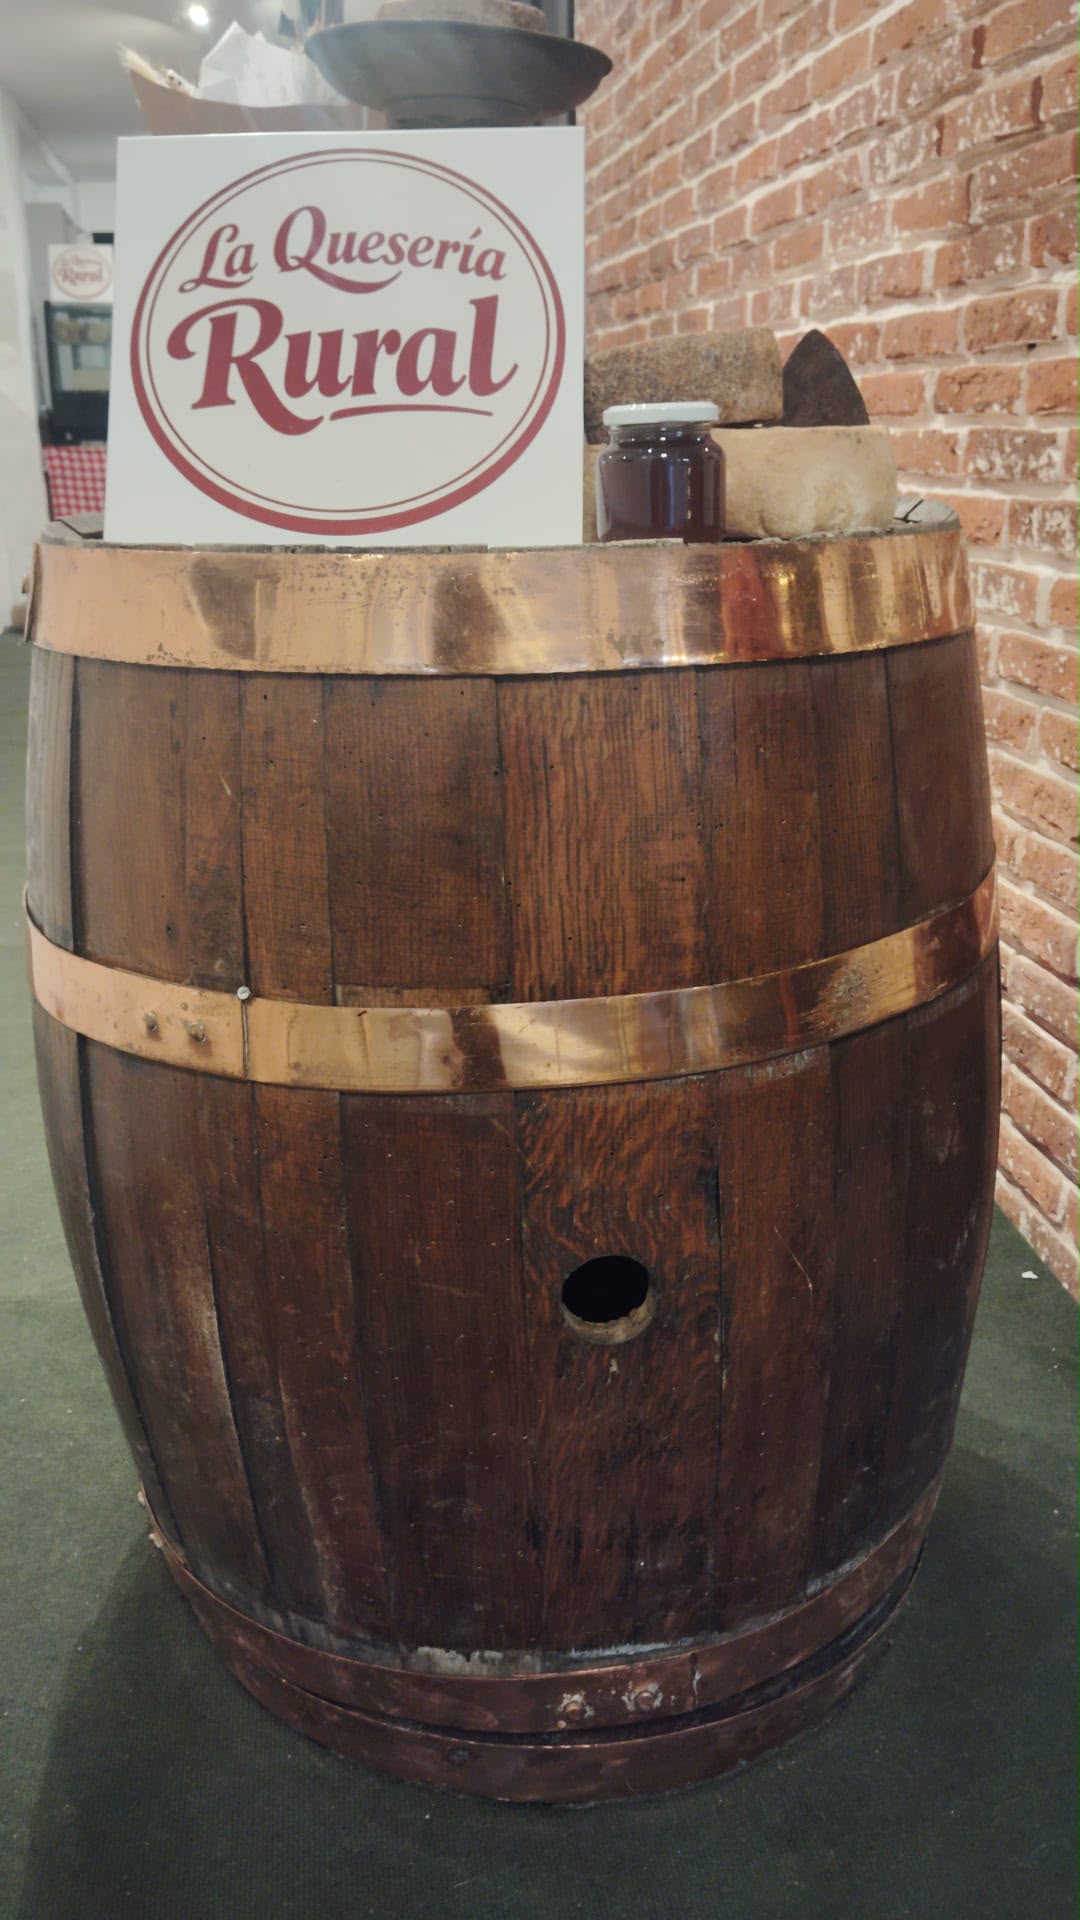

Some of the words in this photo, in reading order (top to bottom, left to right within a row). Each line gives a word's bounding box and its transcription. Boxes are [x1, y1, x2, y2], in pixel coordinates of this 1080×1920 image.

[178, 223, 258, 294] La
[273, 205, 507, 294] Quesería
[166, 294, 519, 436] Rural
